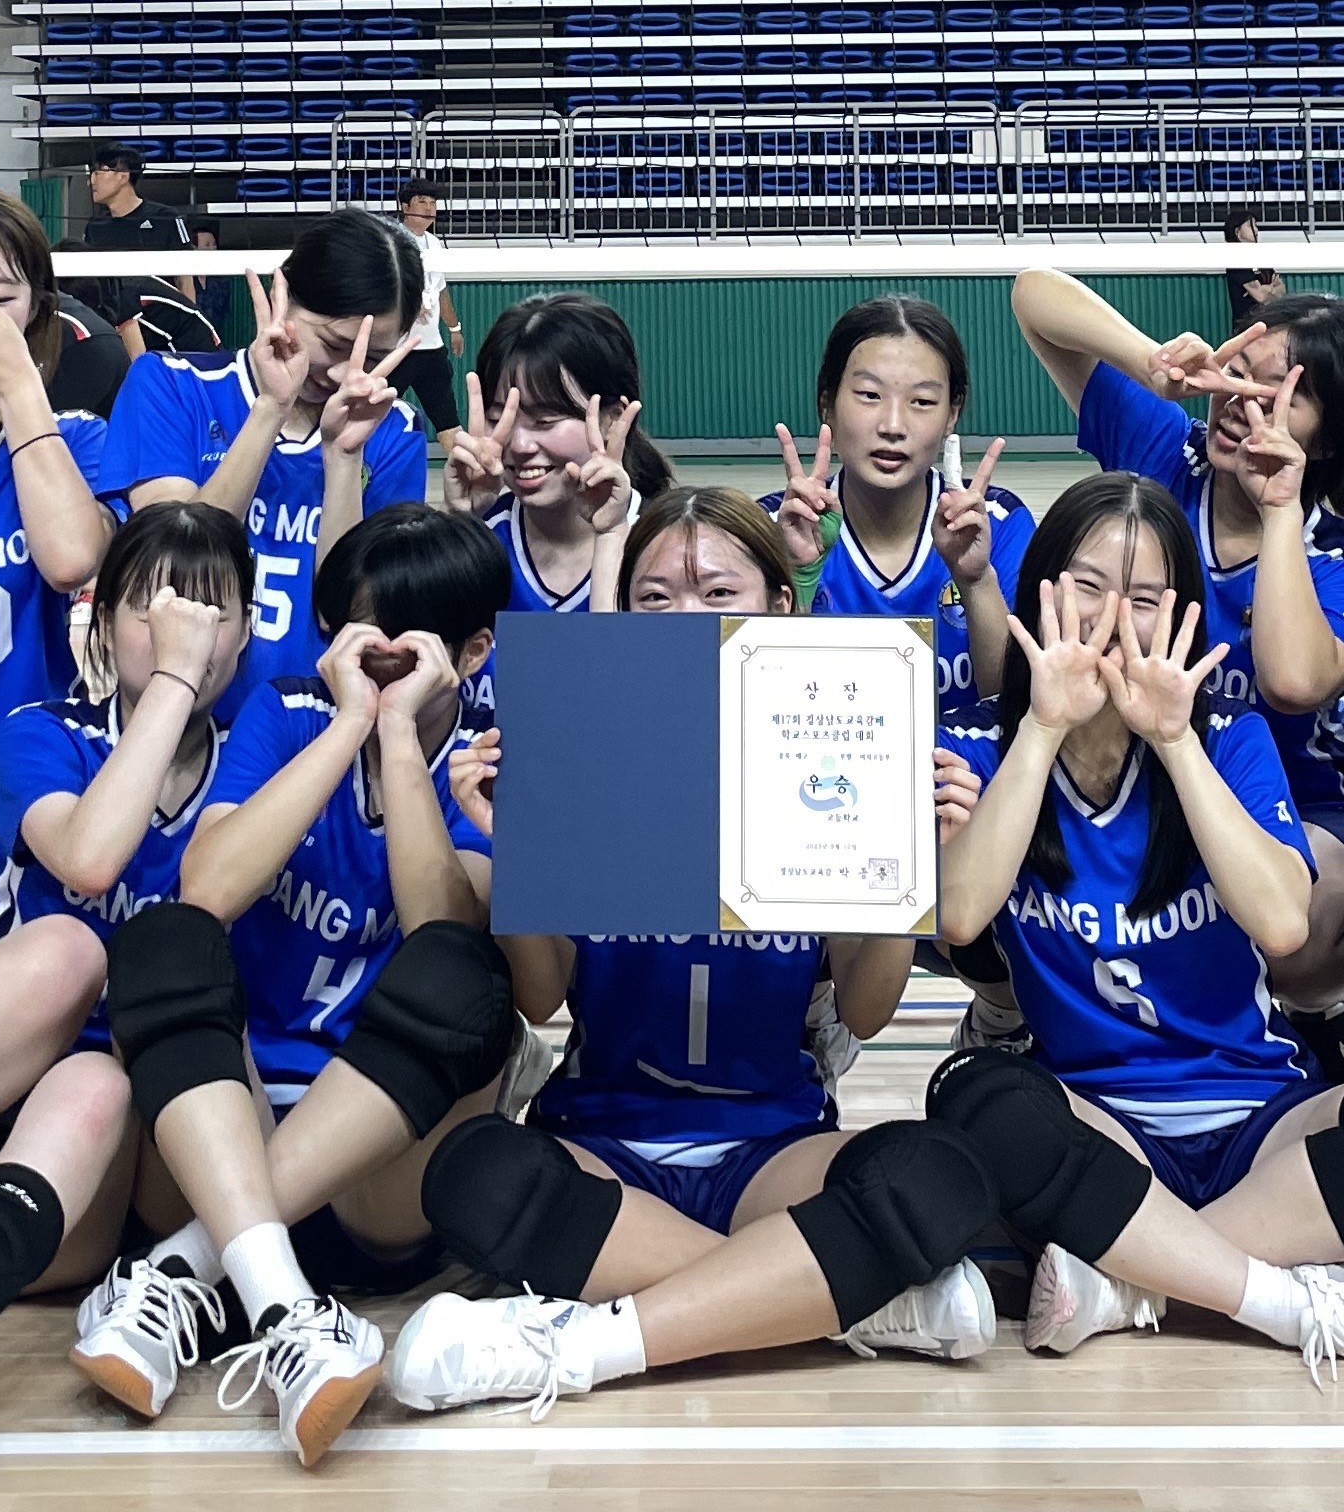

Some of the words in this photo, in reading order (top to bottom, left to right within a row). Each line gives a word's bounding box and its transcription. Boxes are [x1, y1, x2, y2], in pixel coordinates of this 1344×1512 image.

[249, 548, 300, 641] 5
[806, 774, 851, 794] 우승
[264, 869, 351, 942] ANG
[303, 955, 366, 1032] 4
[688, 964, 709, 1065] 1
